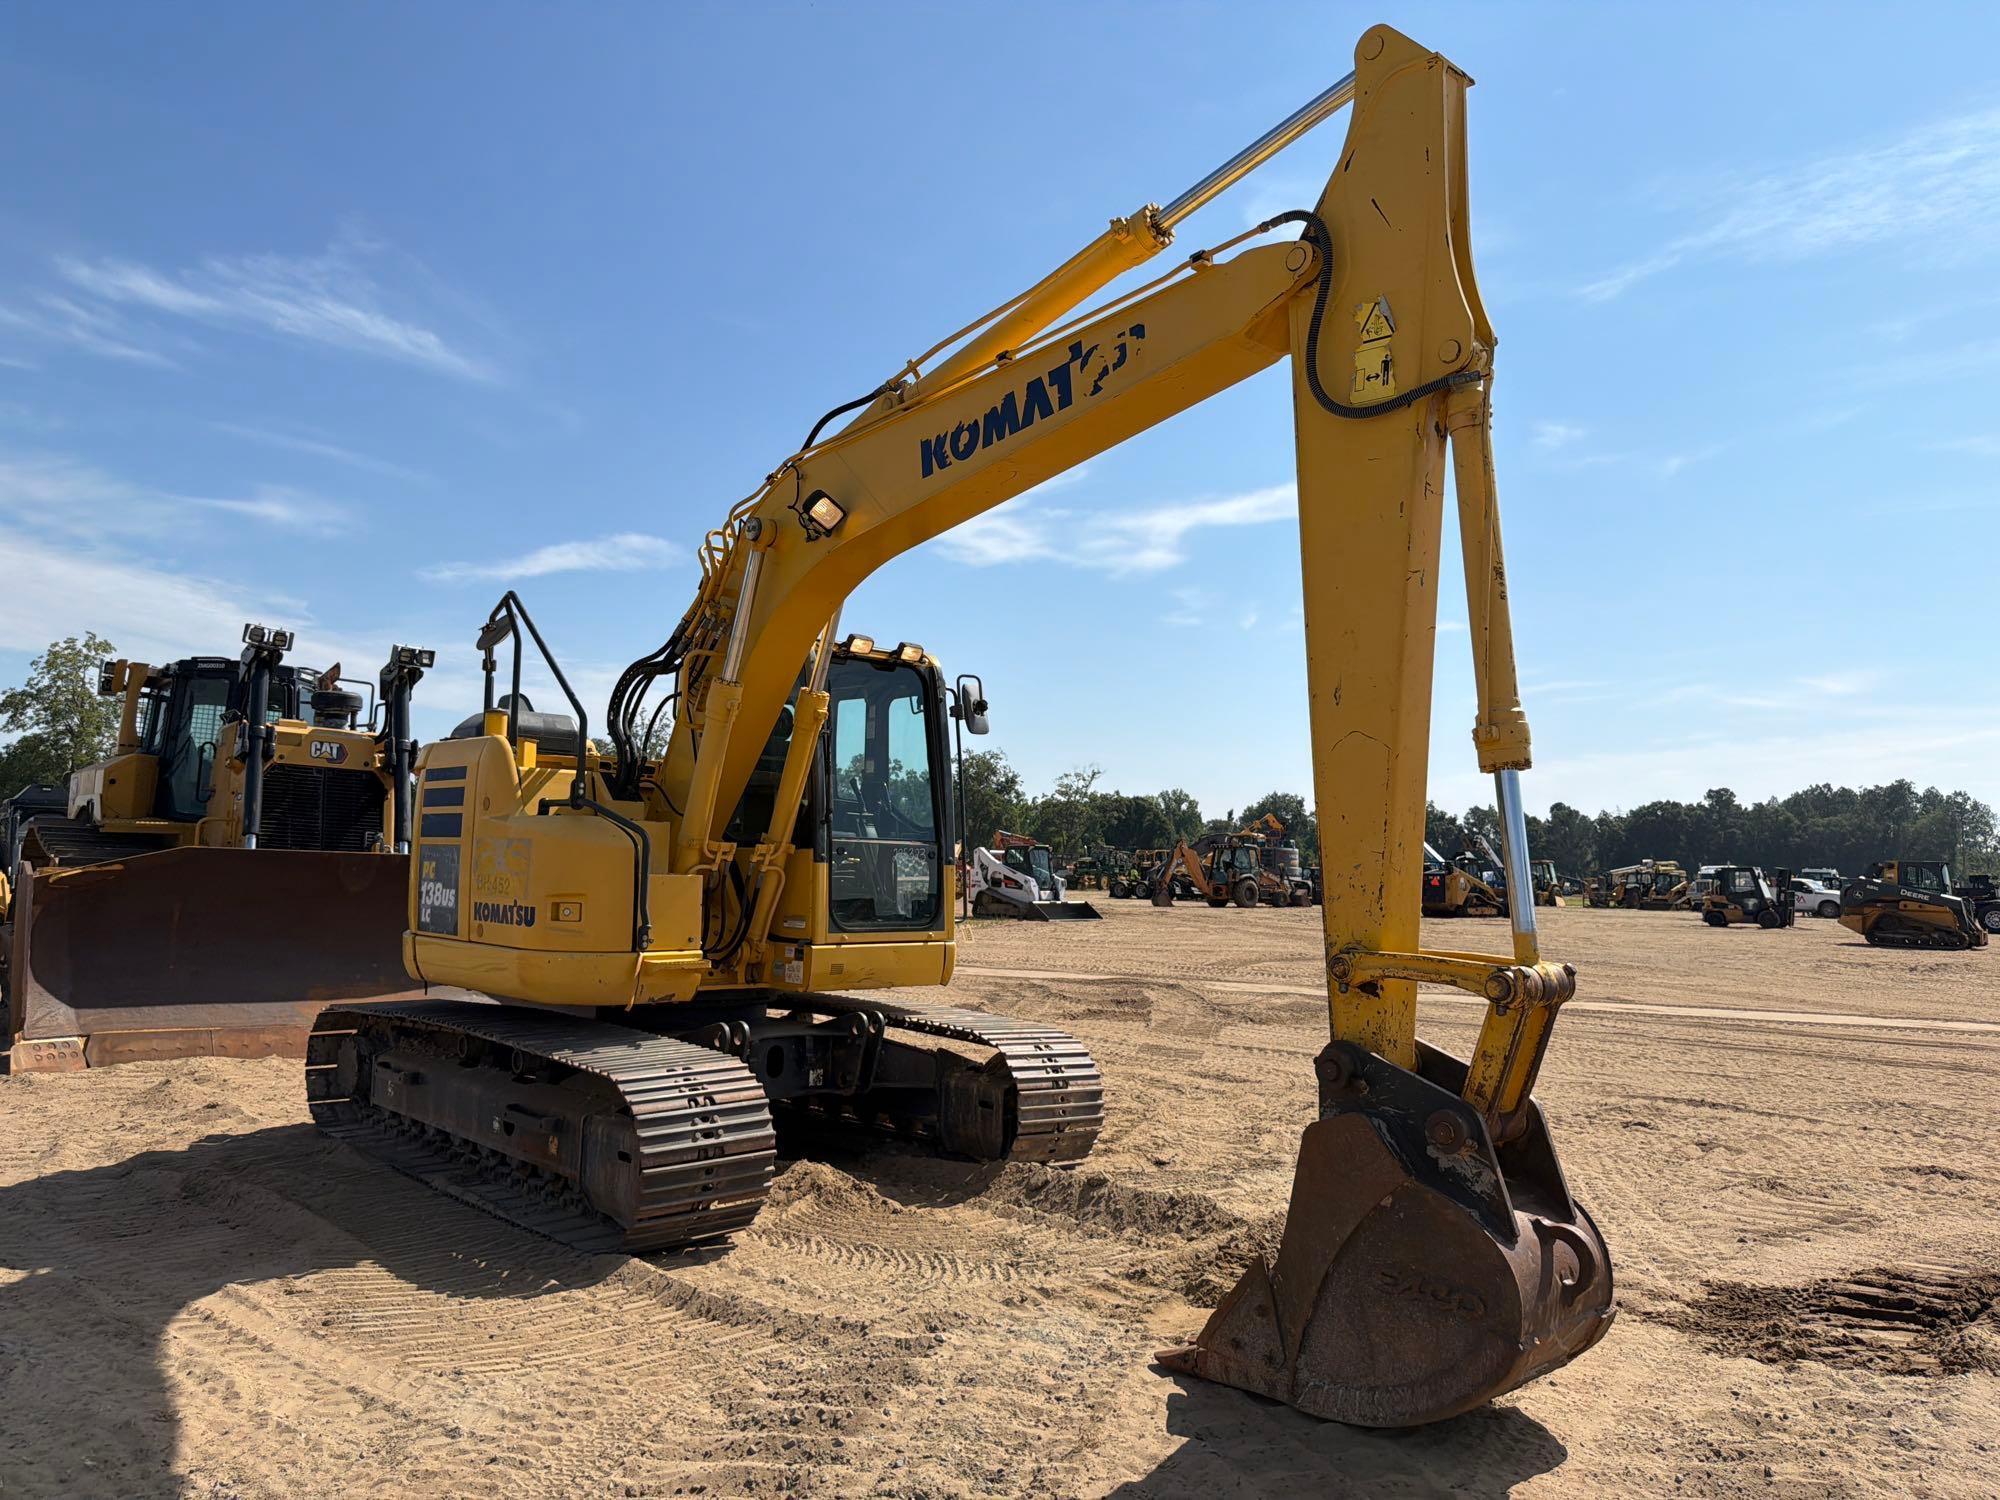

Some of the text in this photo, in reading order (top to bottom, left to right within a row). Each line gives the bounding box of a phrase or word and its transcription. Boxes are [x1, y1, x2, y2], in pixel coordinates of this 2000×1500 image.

[920, 323, 1146, 479] KOMAT
[310, 741, 340, 760] CAT
[422, 860, 436, 880] PC
[1900, 888, 1931, 901] DEERE
[420, 908, 432, 923] LC
[473, 899, 536, 928] KOMATSU
